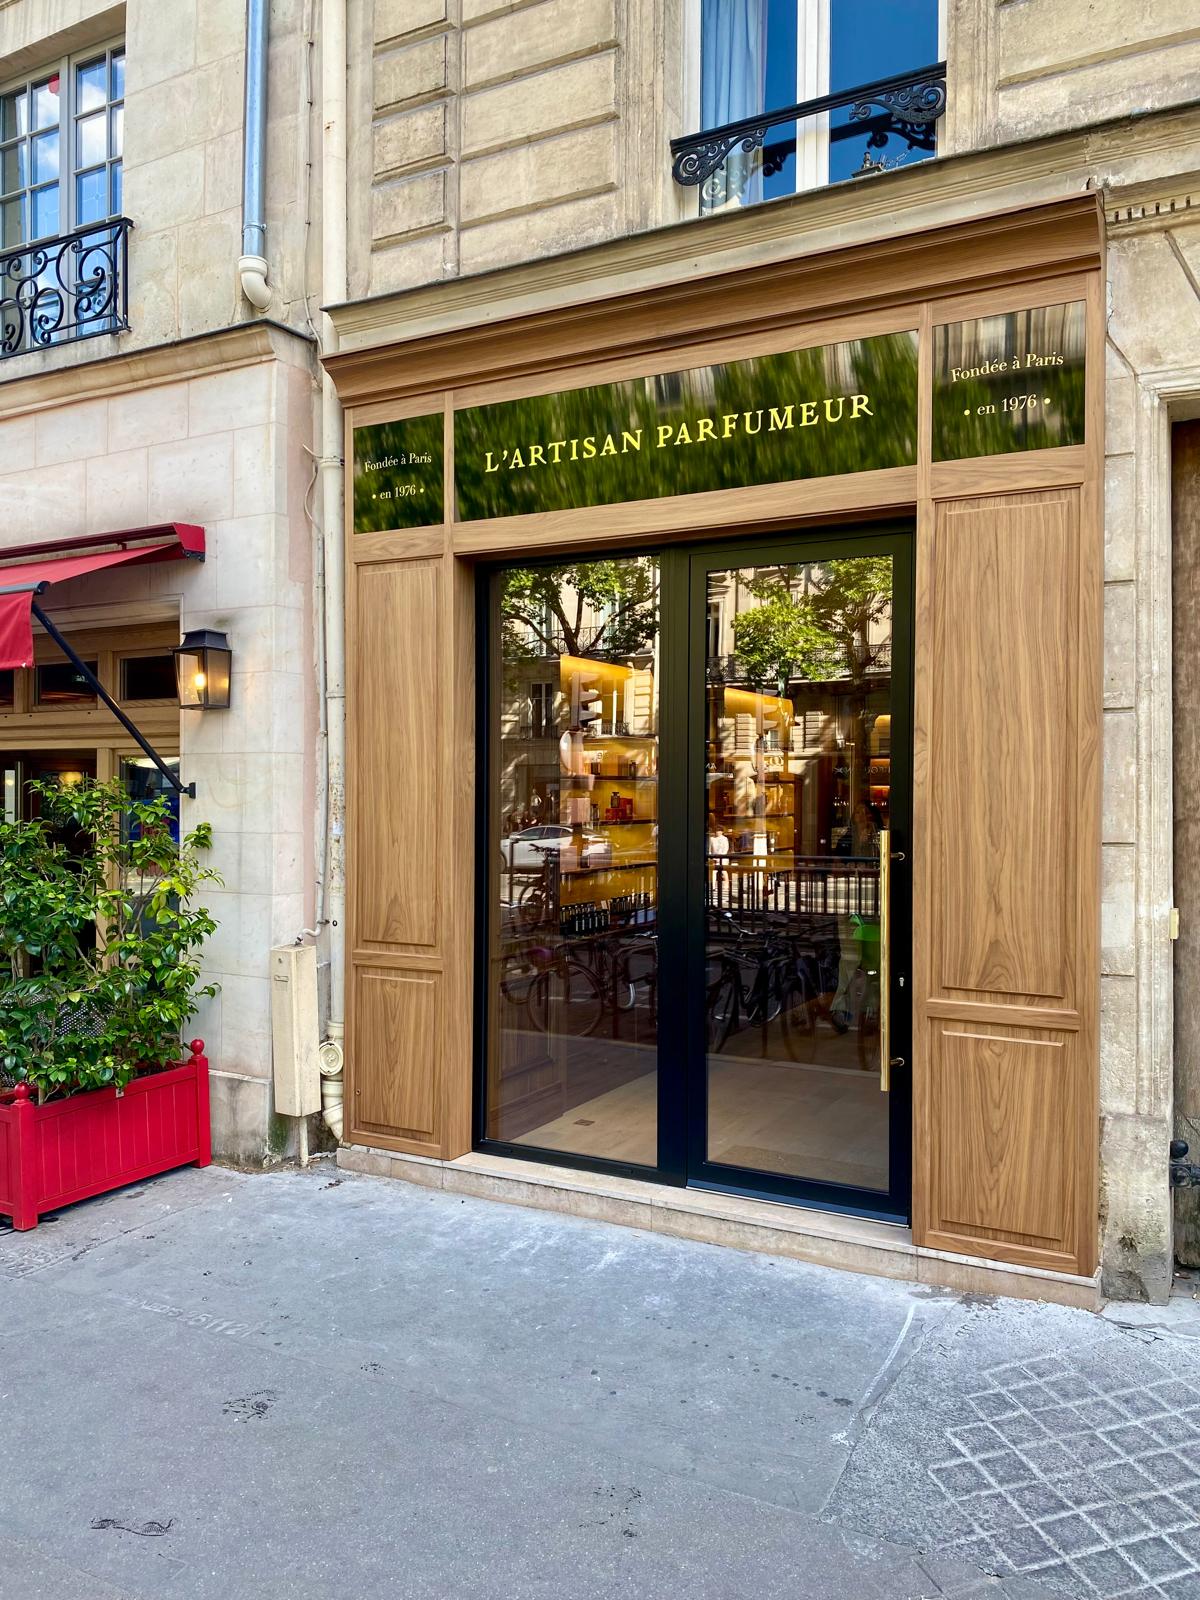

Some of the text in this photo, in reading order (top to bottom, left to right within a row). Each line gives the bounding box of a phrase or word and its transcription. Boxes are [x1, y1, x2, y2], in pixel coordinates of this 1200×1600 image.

[951, 351, 1064, 382] Fondée à Paris
[977, 394, 1037, 415] en 1976
[656, 394, 874, 448] PARFUMEUR
[364, 451, 432, 472] Fondée à Paris
[380, 484, 416, 500] en 1976
